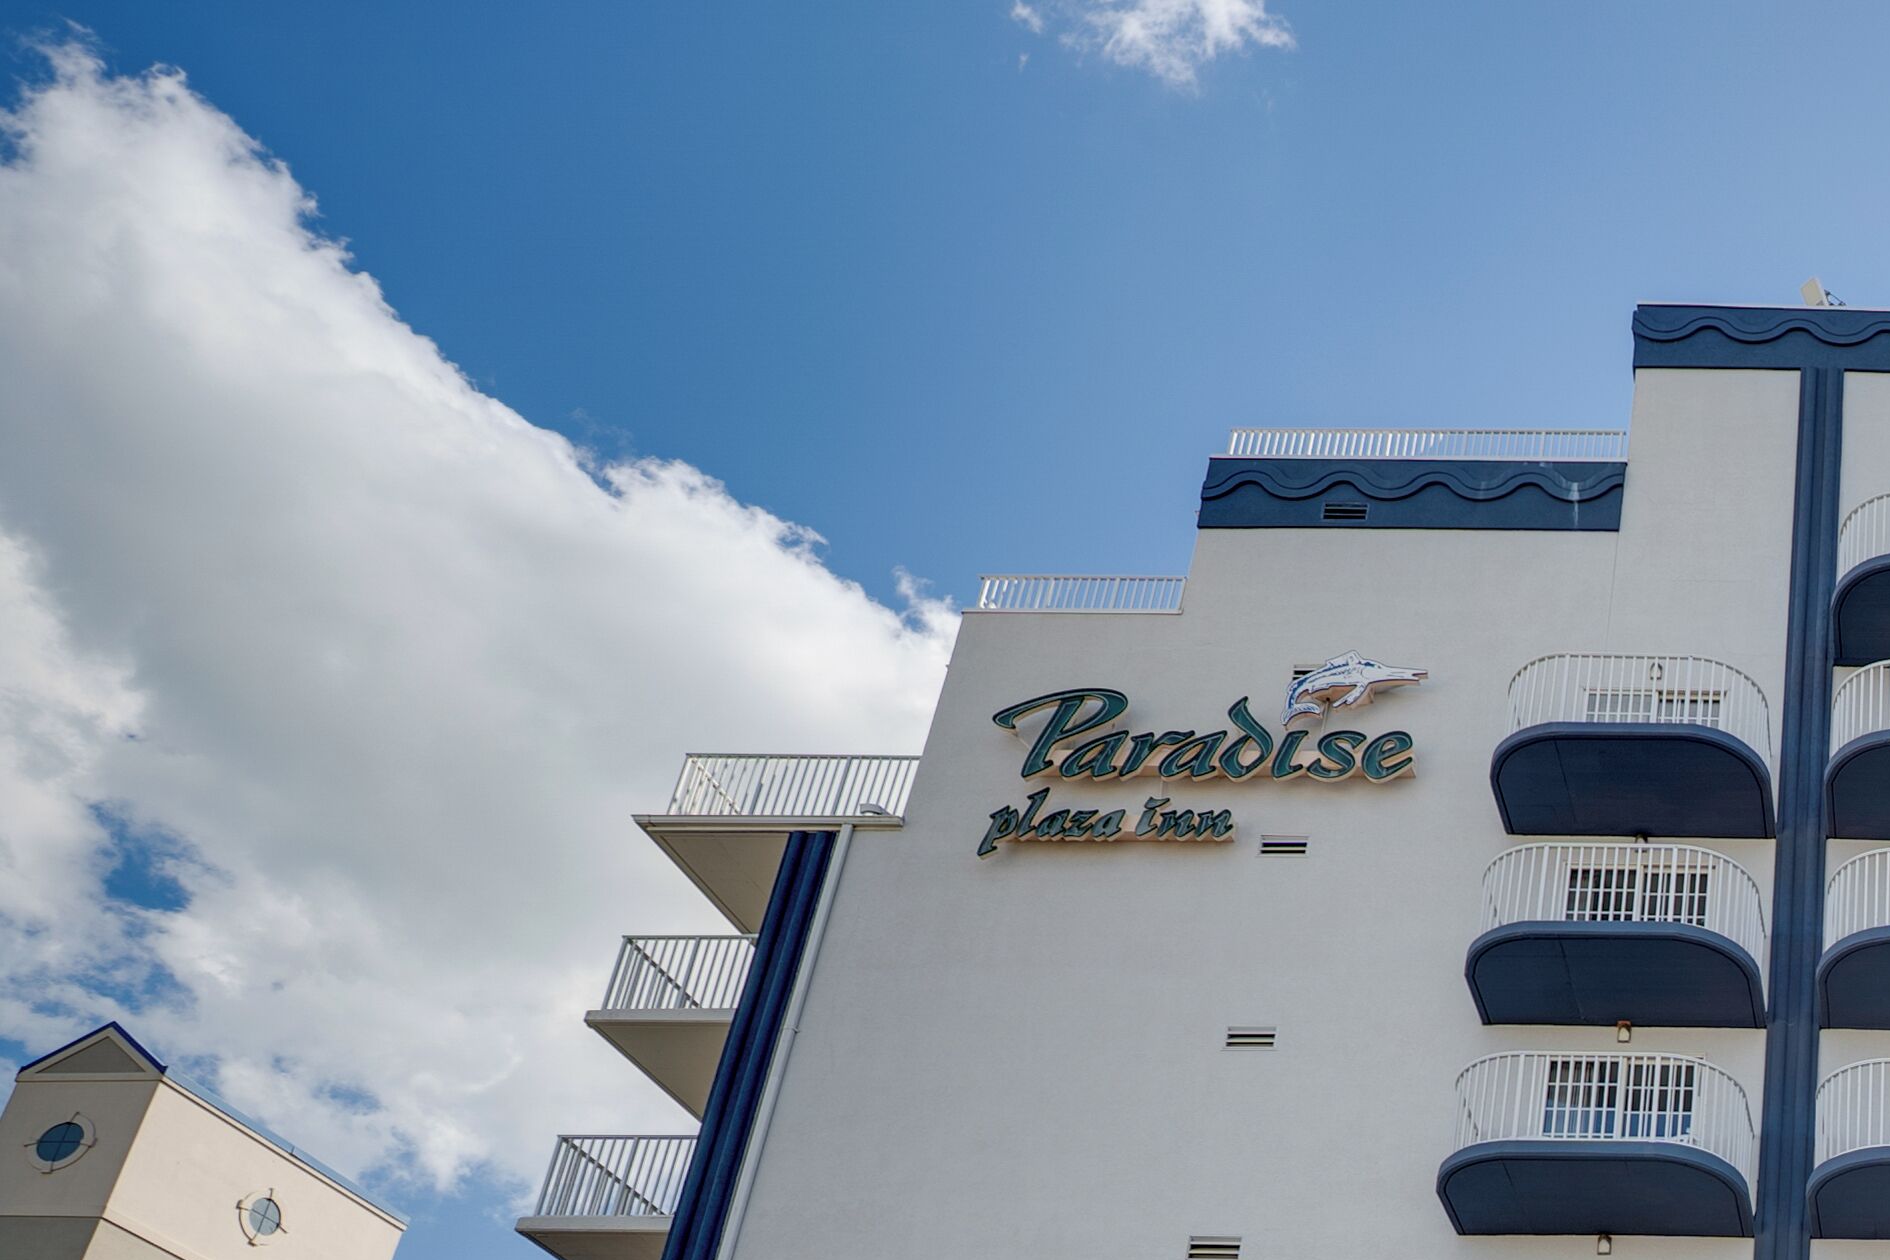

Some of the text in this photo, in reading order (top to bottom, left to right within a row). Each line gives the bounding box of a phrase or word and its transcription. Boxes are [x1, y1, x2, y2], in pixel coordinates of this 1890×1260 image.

[992, 687, 1415, 783] Paradise
[977, 786, 1235, 860] plaza inn
